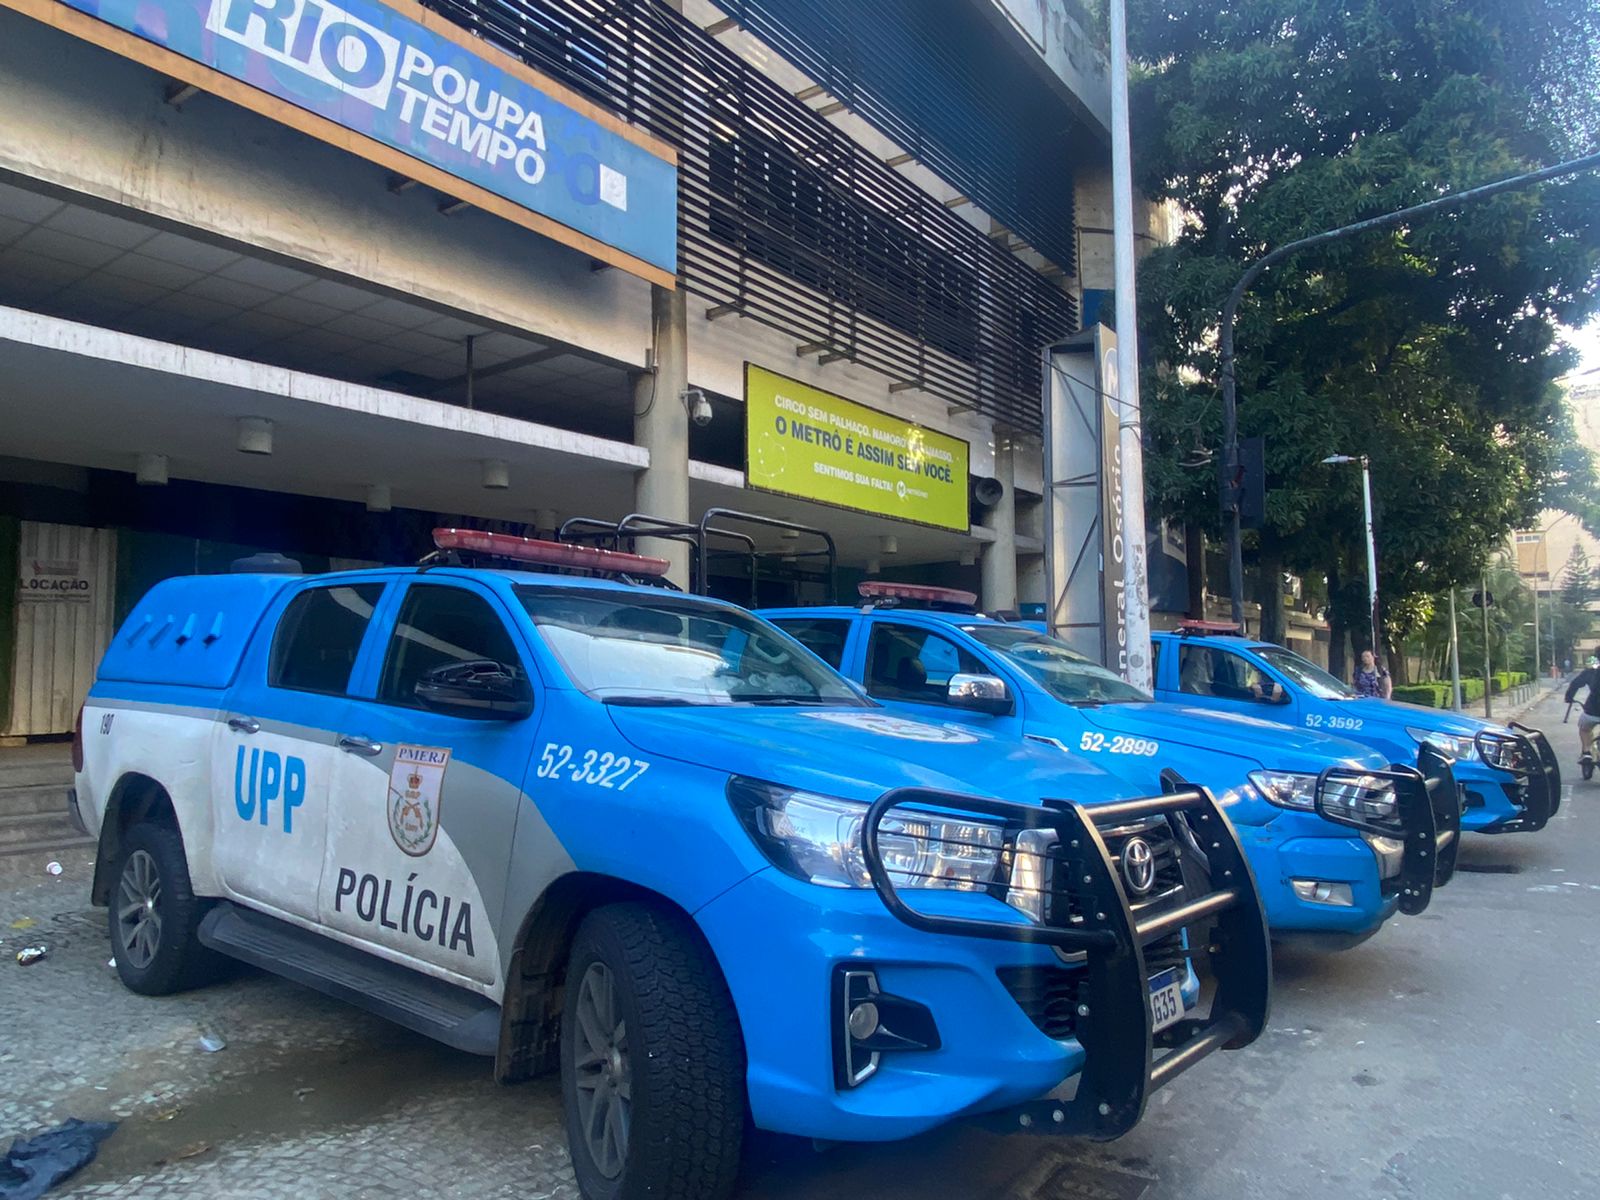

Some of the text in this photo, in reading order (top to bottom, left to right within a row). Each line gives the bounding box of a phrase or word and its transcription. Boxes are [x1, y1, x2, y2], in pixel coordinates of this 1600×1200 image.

[224, 0, 386, 89] RIO
[399, 44, 547, 151] POUPA
[396, 81, 546, 185] TEMPO
[775, 394, 806, 416] CIRCO
[808, 406, 828, 424] SEM
[830, 414, 871, 438] PALHAÇO.
[873, 428, 906, 448] NAMORO
[775, 415, 787, 435] O
[792, 420, 842, 451] METRÔ
[846, 434, 853, 455] É
[858, 442, 894, 467] ASSIM
[924, 462, 954, 484] VOCÊ.
[814, 462, 854, 482] SENTIMOS
[855, 473, 870, 486] SUA
[871, 478, 894, 492] FALTA!
[20, 577, 89, 593] LOCAÇÃO
[100, 713, 114, 735] 190
[1080, 731, 1159, 757] 52-2899
[1305, 713, 1364, 731] 52-3592
[398, 748, 446, 763] PMERJ
[537, 742, 650, 792] 52-3327
[235, 744, 306, 834] UPP
[335, 867, 475, 957] POLÍCIA
